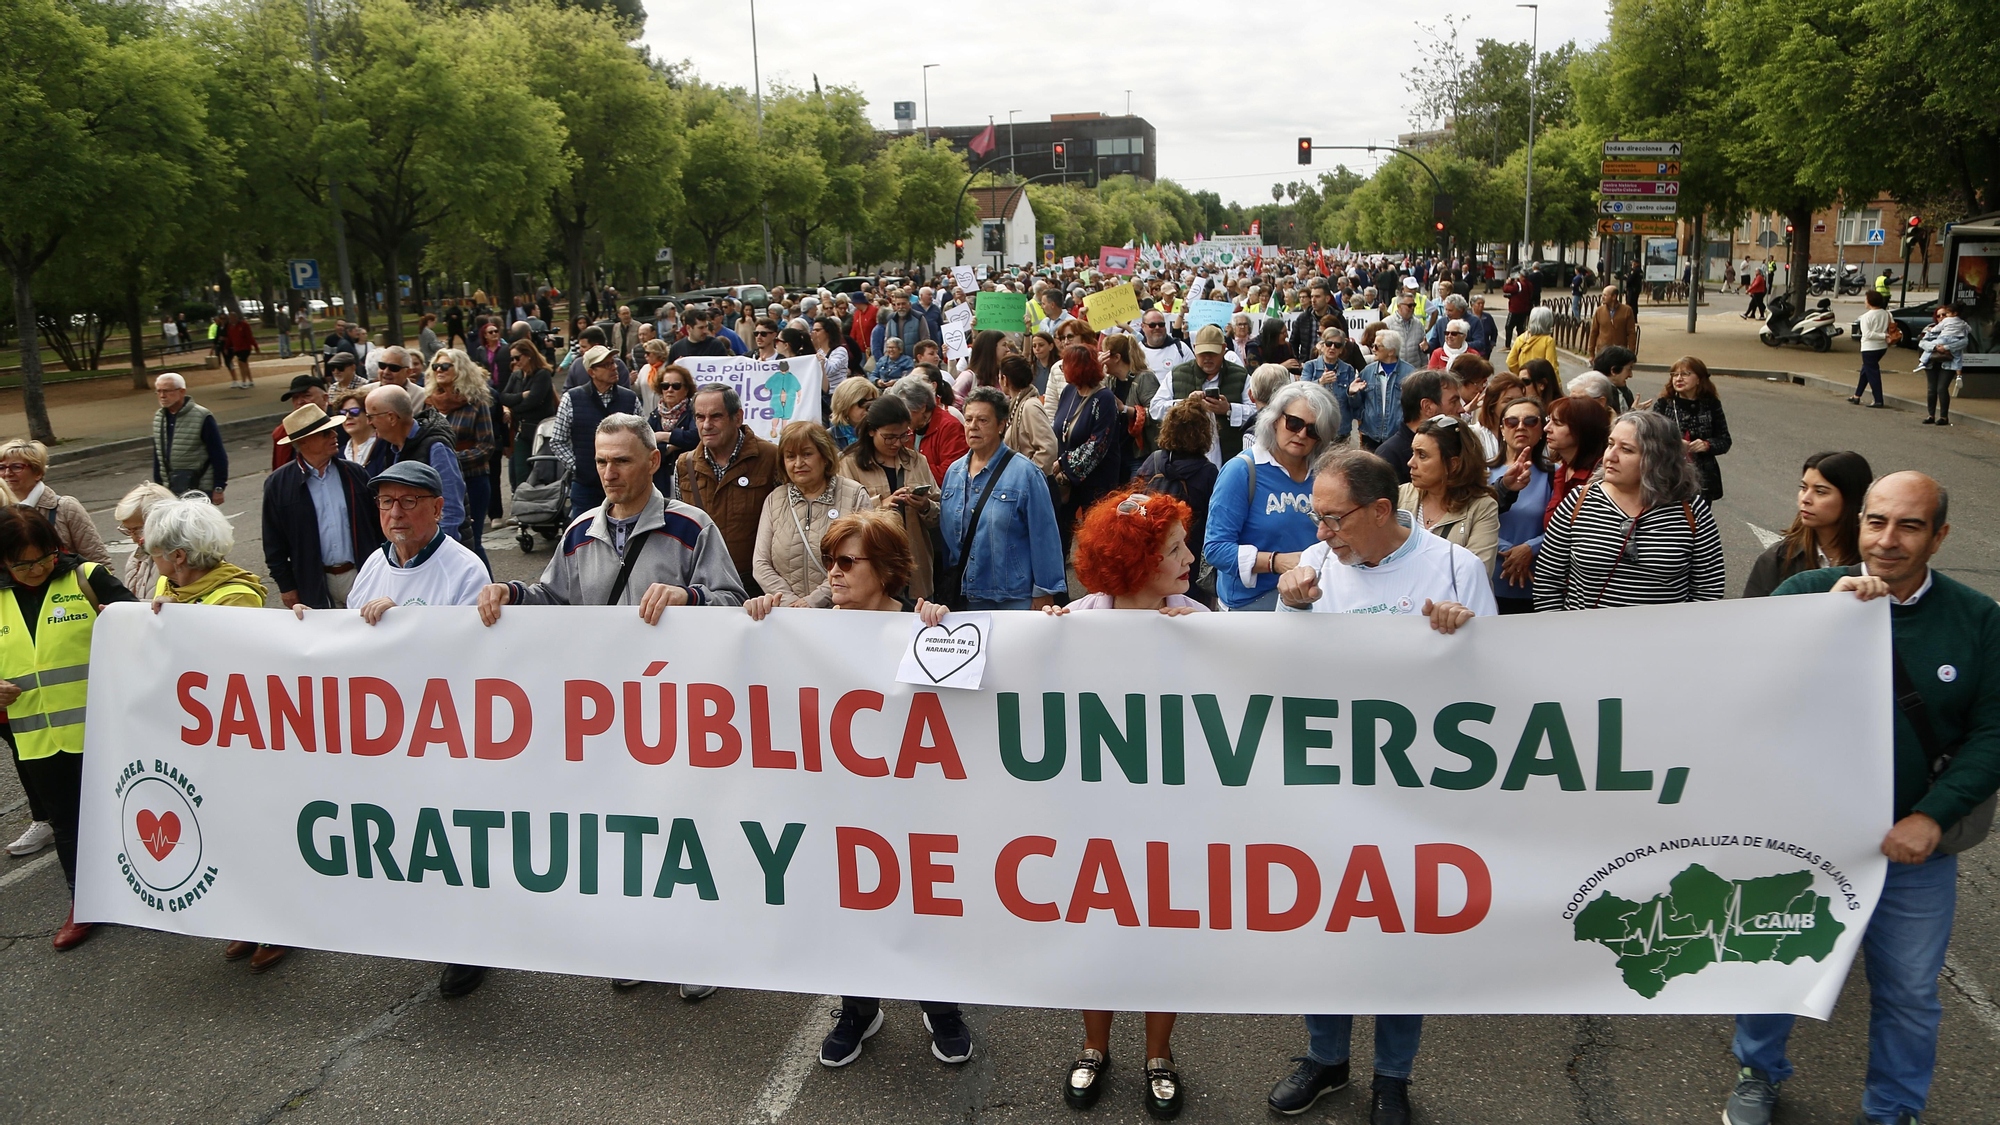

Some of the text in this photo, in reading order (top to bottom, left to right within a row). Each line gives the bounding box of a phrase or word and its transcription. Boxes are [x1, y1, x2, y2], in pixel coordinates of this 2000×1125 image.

[295, 263, 313, 286] P
[1090, 288, 1129, 307] PEDIATRA
[1093, 307, 1126, 325] NARANJO
[697, 362, 780, 374] La pública
[729, 373, 743, 382] el
[744, 404, 774, 420] ire
[48, 612, 88, 624] Flautas
[926, 646, 955, 654] NARANJO
[178, 661, 1689, 804] SANIDAD PÚBLICA UNIVERSAL,
[115, 759, 203, 808] MAREA BLANCA
[297, 800, 1492, 935] GRATUITA Y DE CALIDAD
[118, 852, 218, 912] CÓRDOBA CAPITAL
[1562, 835, 1861, 921] COORDINADORA ANDALUZA DE MAREAS BLANCAS
[1754, 914, 1816, 929] CAMB
